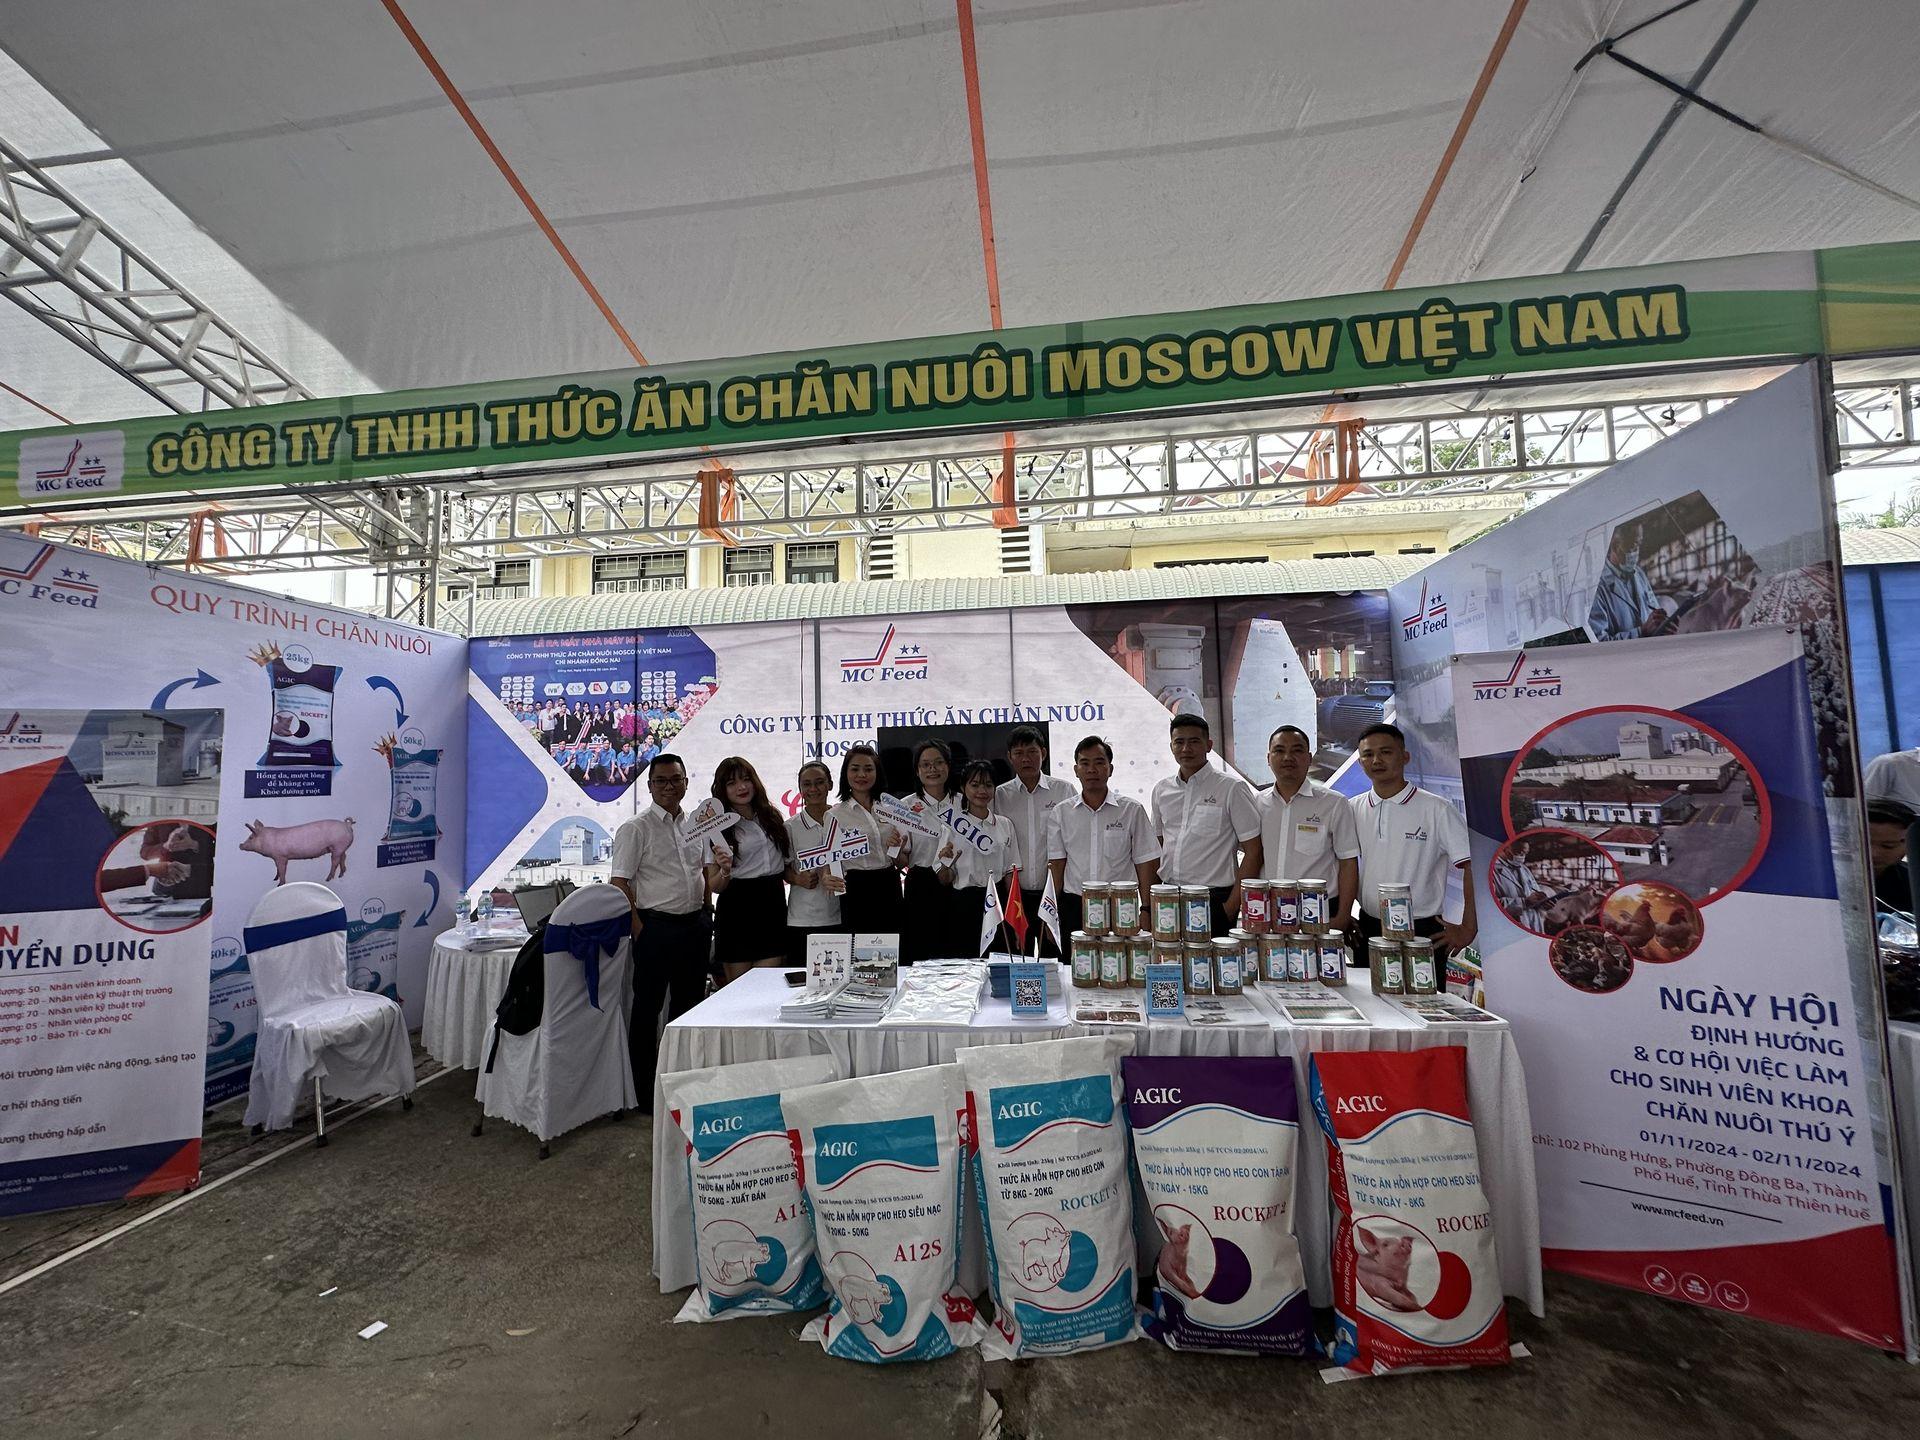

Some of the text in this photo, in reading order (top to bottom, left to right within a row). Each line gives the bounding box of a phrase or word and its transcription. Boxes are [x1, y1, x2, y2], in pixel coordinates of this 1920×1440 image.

[150, 291, 1682, 475] CÔNG TY TNHH THỨC ĂN CHĂN NUÔI MOSCOW VIỆT NAM
[36, 476, 104, 493] MC Feed
[29, 584, 98, 609] Feed
[150, 585, 431, 656] QUY TRÌNH CHĂN NUÔI
[1404, 614, 1448, 642] MC Feed
[286, 653, 310, 665] 25kg
[841, 665, 928, 683] MC Feed
[1474, 685, 1562, 701] MC Feed
[720, 701, 1105, 734] CÔNG TY TNHH THỨC ĂN CHĂN NUÔI
[10, 735, 41, 744] Feed
[403, 735, 422, 746] 50kg
[938, 808, 994, 851] AGIC
[801, 843, 869, 870] MC Feed
[363, 906, 383, 917] 75kg
[0, 939, 154, 970] YỂN DỤNG
[50, 982, 73, 991] Nhân
[76, 980, 94, 989] viên
[97, 977, 115, 987] kinh
[117, 977, 141, 986] doanh
[28, 998, 40, 1006] 20
[49, 994, 72, 1003] Nhân
[75, 991, 94, 1000] viên
[108, 988, 130, 998] thuật
[145, 986, 173, 996] trường
[1660, 985, 1839, 1032] NGÀY HỘI
[1690, 1025, 1844, 1056] ĐỊNH HƯỚNG
[18, 1067, 53, 1079] trường
[56, 1065, 74, 1074] làm
[76, 1062, 96, 1073] việc
[98, 1060, 122, 1070] năng
[155, 1054, 178, 1064] sáng
[181, 1052, 196, 1062] tạo
[1634, 1046, 1849, 1087] & CƠ HỘI VIỆC LÀM
[11, 1100, 28, 1111] hội
[62, 1093, 82, 1104] tiến
[1134, 1088, 1181, 1104] AGIC
[1610, 1069, 1854, 1118] CHO SINH VIÊN KHOA
[998, 1102, 1042, 1120] AGIC
[1335, 1095, 1387, 1114] AGIC
[699, 1116, 742, 1135] AGIC
[1646, 1097, 1856, 1147] CHĂN NUÔI THÚ Ý
[820, 1142, 858, 1157] AGIC
[1640, 1129, 1861, 1178] 01/11/2024 02/11/2024
[999, 1160, 1105, 1185] THỨC ĂN HỖN HỢP CHO HEO CON
[1194, 1165, 1269, 1178] HỢP CHO HEO CON
[1532, 1134, 1868, 1203] chỉ: 102 Phùng Hưng, Phường Đông Ba, Thành
[697, 1174, 789, 1192] THỨC ĂN HỖN HỢP CHO HEO
[1160, 1182, 1208, 1195] NGÀY 15KG
[1413, 1175, 1464, 1190] HỢP CHO HEO
[708, 1190, 766, 1206] 50KG XUẤT BÁN
[1001, 1186, 1053, 1200] TỪ 8KG 20KG
[1060, 1187, 1111, 1211] ROCKET
[1377, 1194, 1425, 1208] NGÀY 8KG
[1634, 1165, 1871, 1220] Phố Huế, Tỉnh Thừa Thiên Huế
[862, 1203, 942, 1223] HỢP CHO HEO SIÊU NẠC
[1213, 1203, 1279, 1222] ROCKET
[1632, 1201, 1724, 1227] www.mcfeed.vn
[852, 1227, 869, 1237] 50KG
[894, 1239, 942, 1262] A12S
